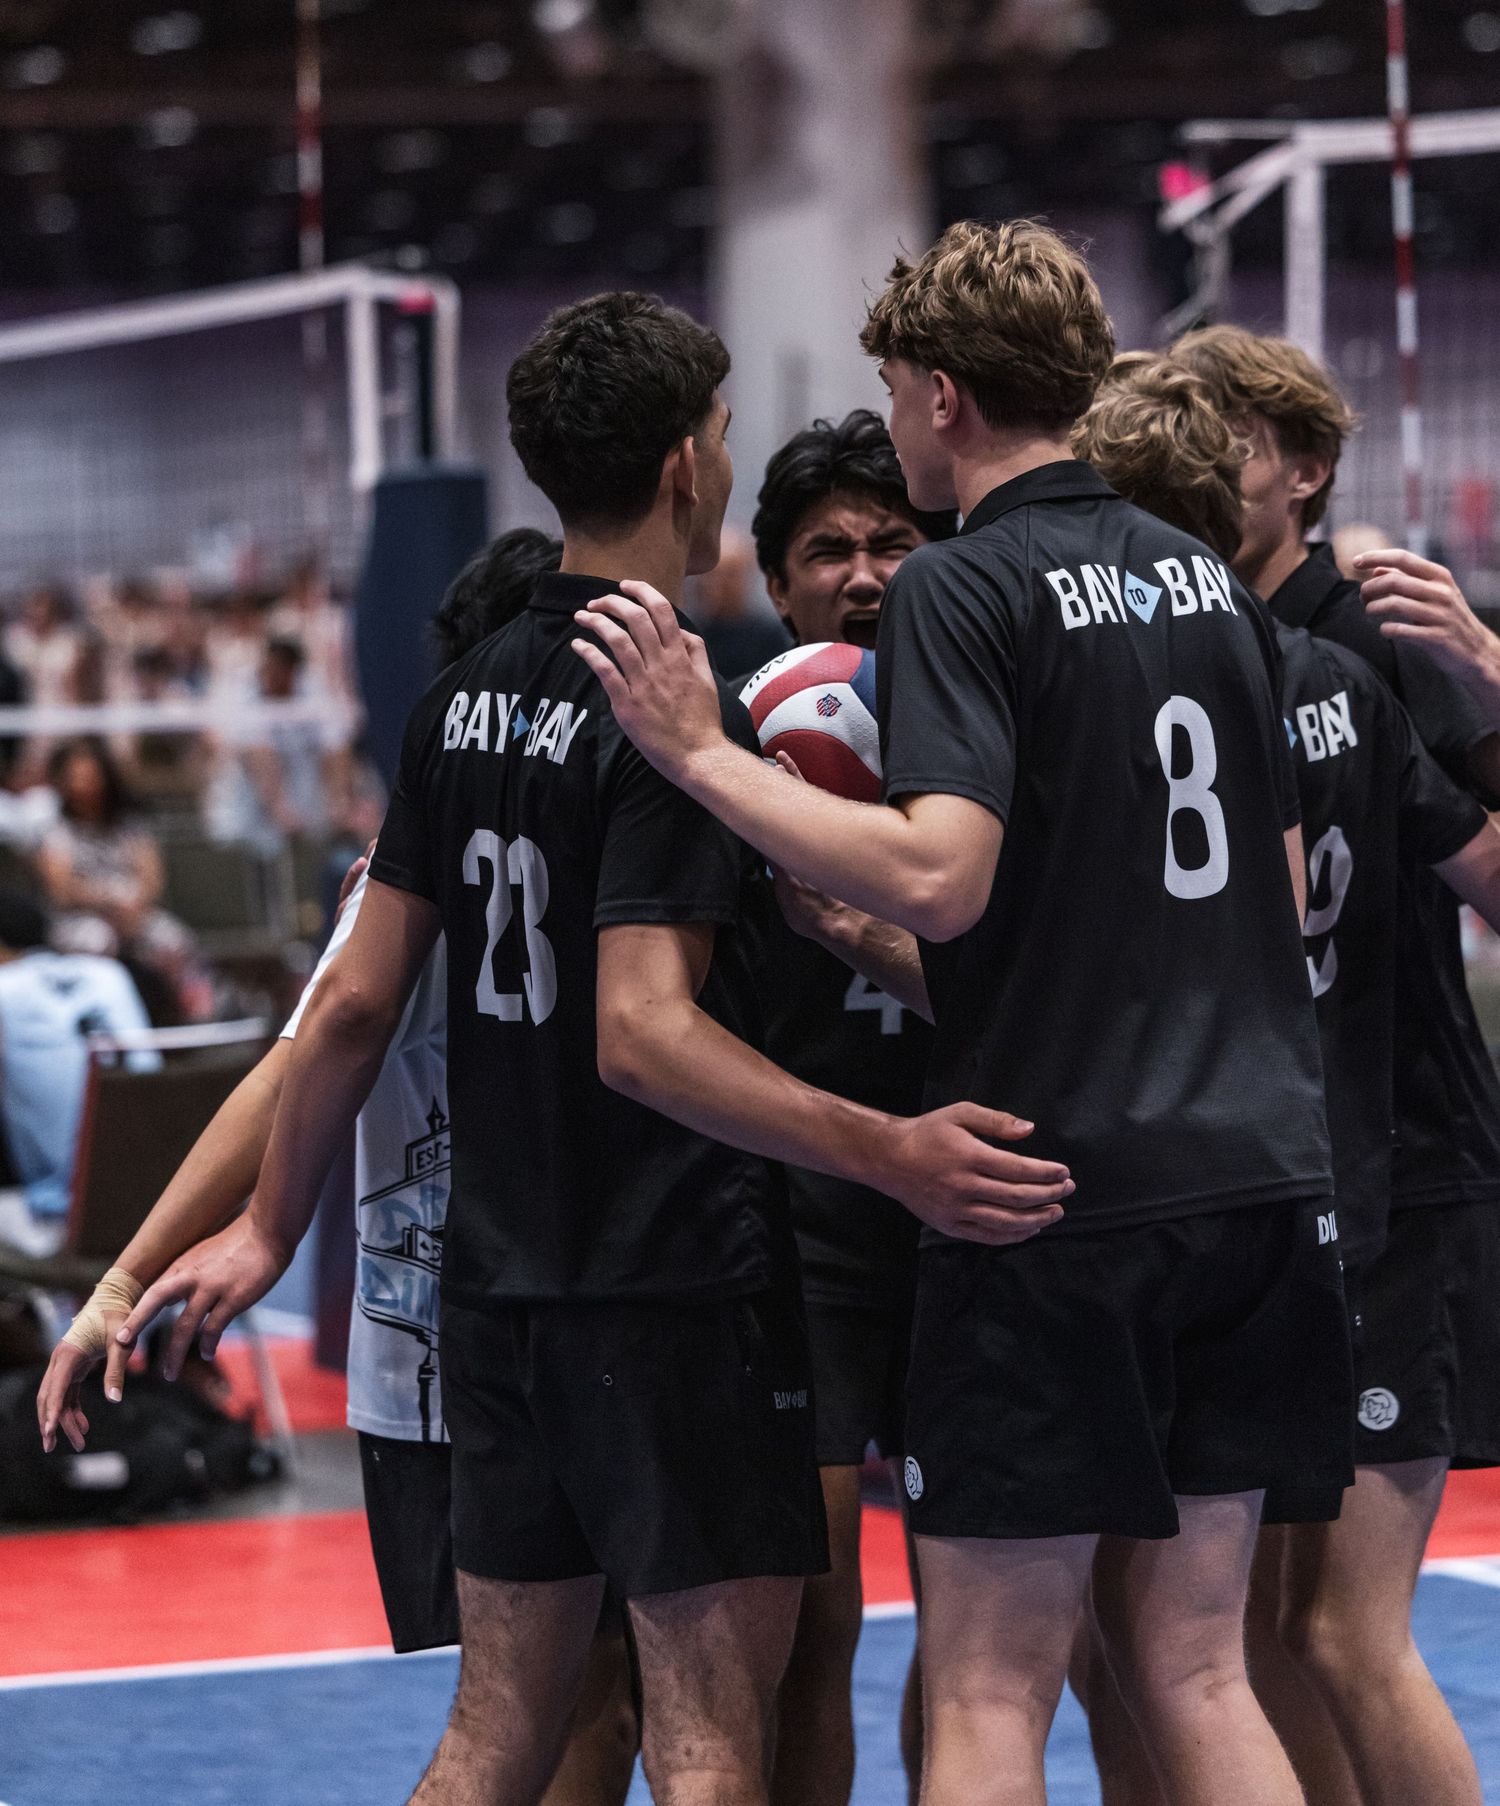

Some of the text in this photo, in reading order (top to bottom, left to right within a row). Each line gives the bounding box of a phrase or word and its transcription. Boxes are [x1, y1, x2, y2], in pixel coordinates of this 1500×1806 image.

[1045, 555, 1238, 631] BAY TO BAY
[443, 690, 588, 765] BAY BAY
[1296, 690, 1358, 762] BAY
[1154, 695, 1229, 900] 8
[462, 829, 558, 1027] 23
